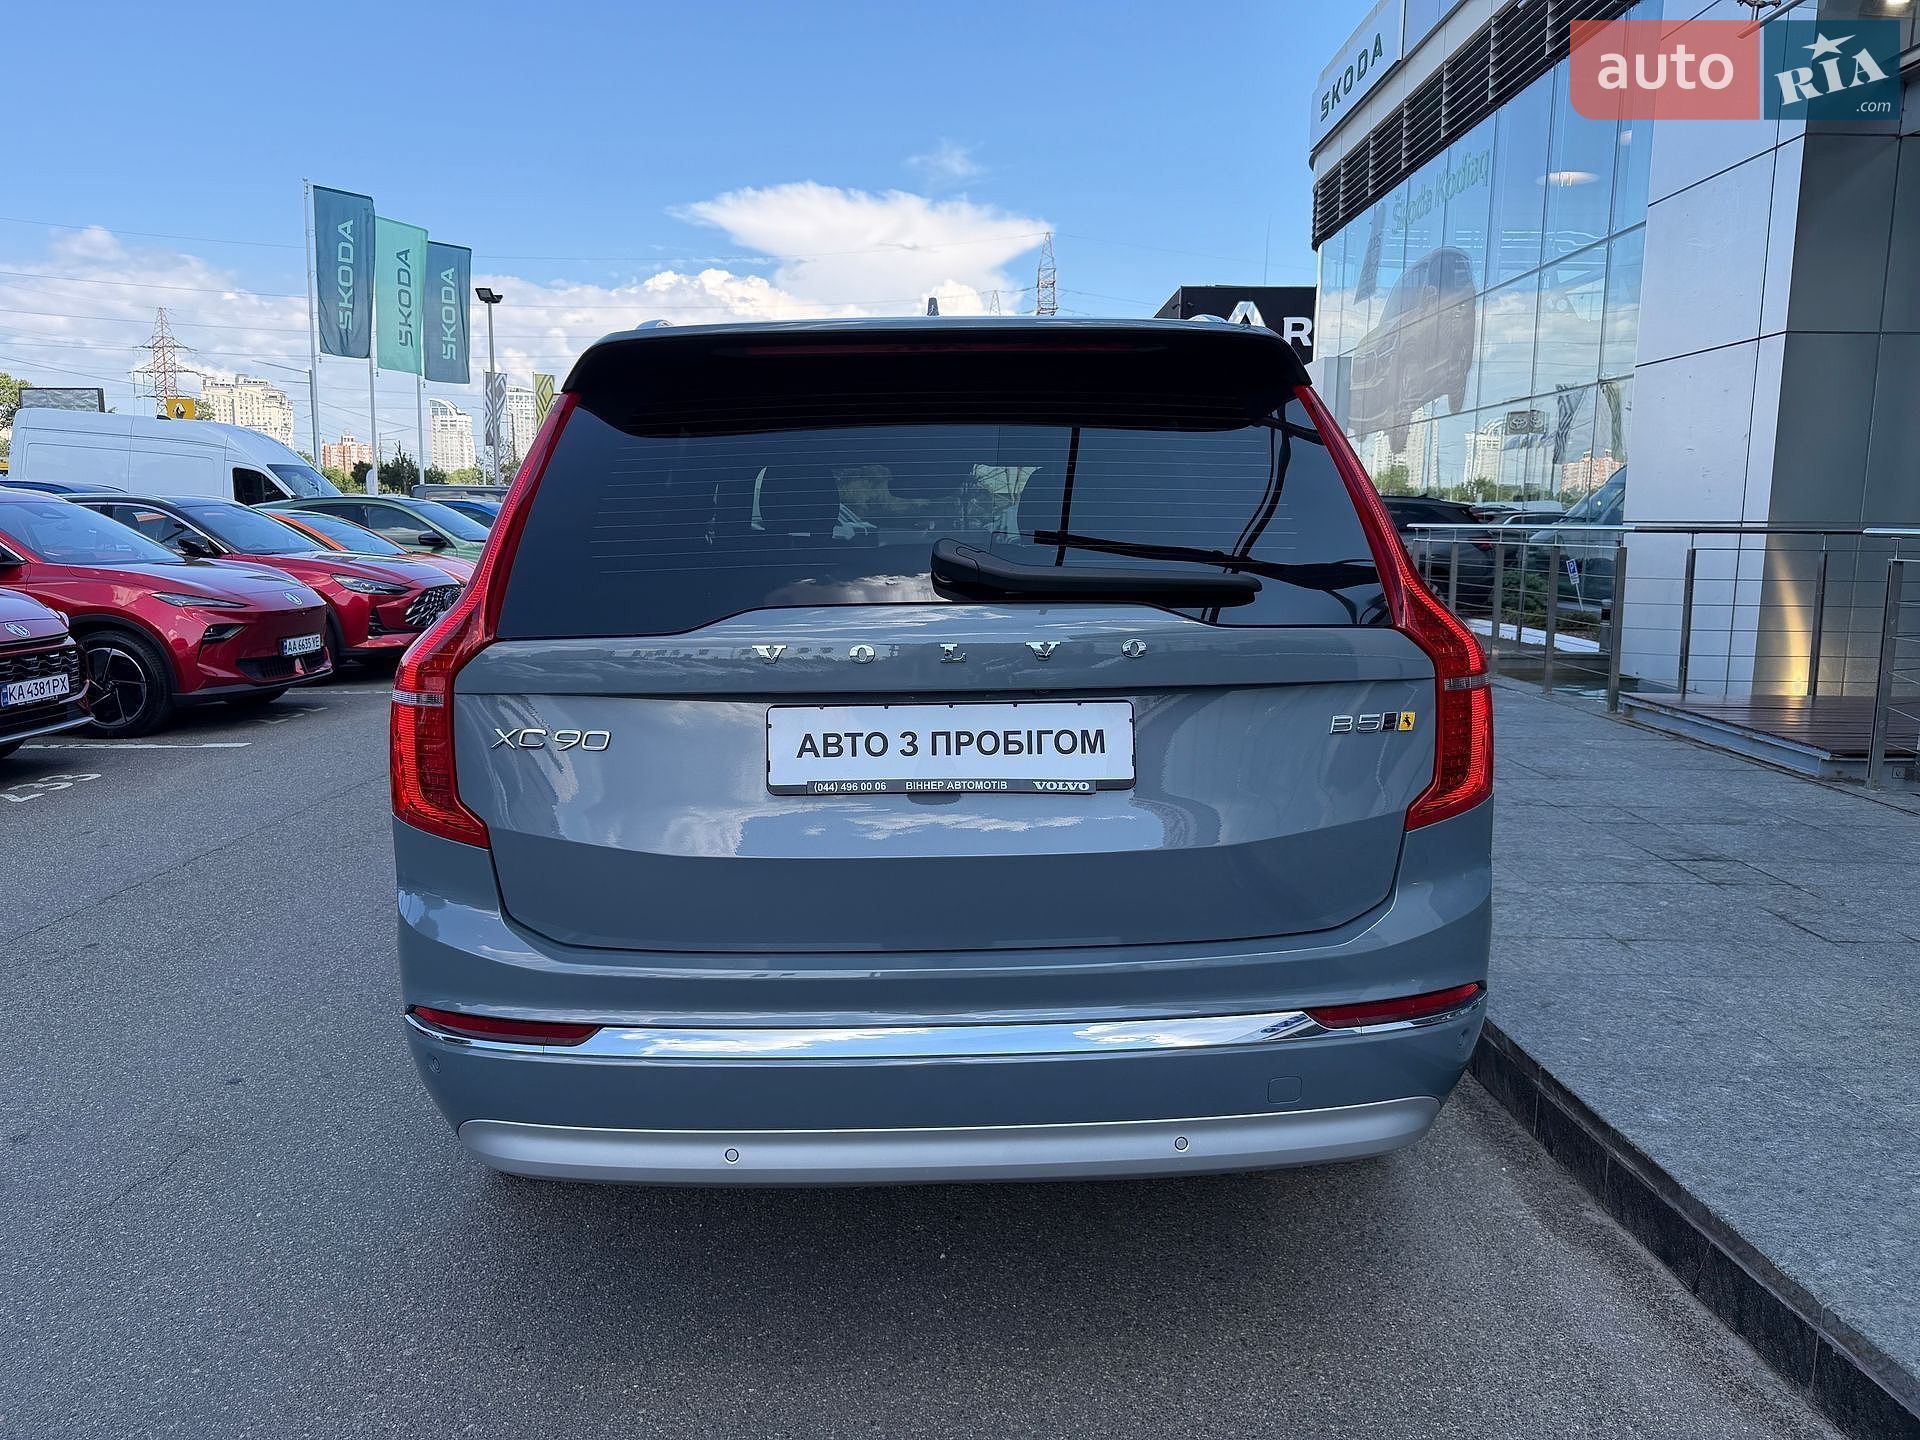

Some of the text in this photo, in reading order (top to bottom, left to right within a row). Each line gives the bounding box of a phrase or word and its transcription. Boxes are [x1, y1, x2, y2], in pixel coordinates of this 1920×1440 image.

[1321, 33, 1383, 122] SKODA
[337, 219, 354, 331] SKODA
[397, 248, 414, 348] SKODA
[440, 267, 456, 361] SKODA
[752, 638, 1147, 664] VOLVO
[9, 684, 25, 702] KA
[27, 679, 51, 697] 4381
[52, 676, 68, 693] PX
[1329, 714, 1381, 733] B5
[796, 731, 889, 758] АВТО
[931, 729, 1106, 755] ПРОБІГОМ
[814, 782, 887, 792] (044) 496 00 06
[905, 780, 1008, 790] ВІННЕР АВТОМОТІВ
[1033, 781, 1090, 791] VOLVO
